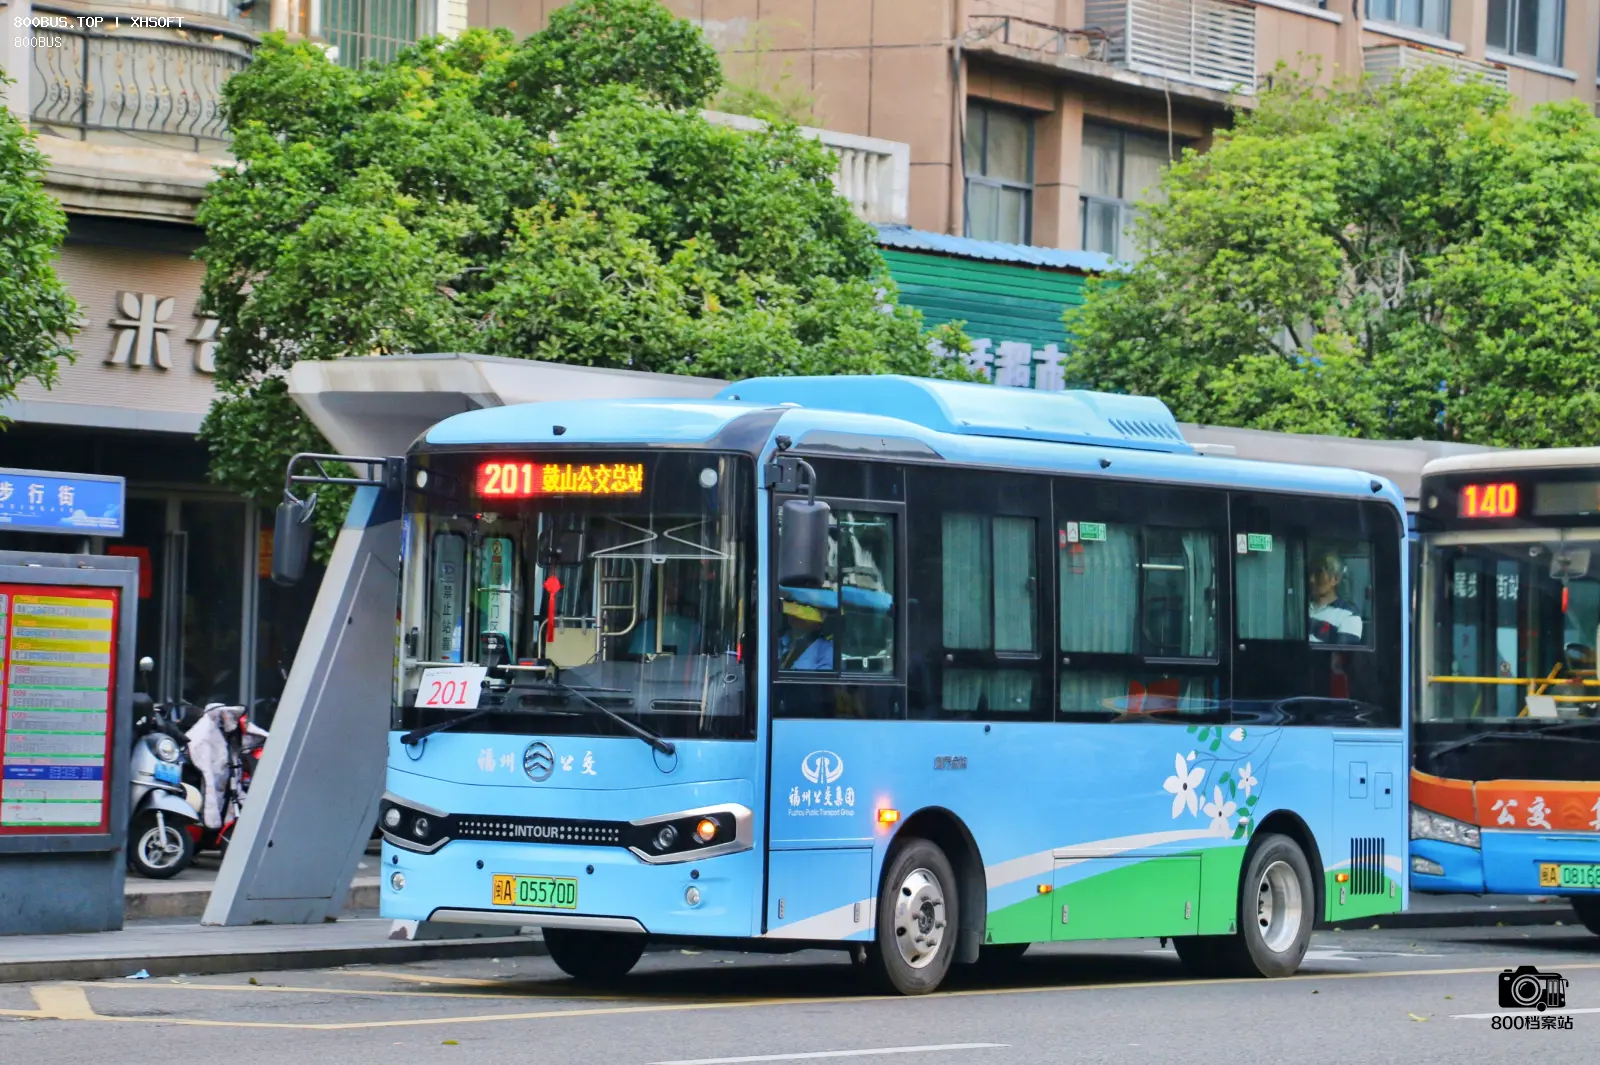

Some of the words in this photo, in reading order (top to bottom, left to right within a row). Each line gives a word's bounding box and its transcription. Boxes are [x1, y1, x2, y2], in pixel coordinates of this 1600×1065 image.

[484, 463, 533, 494] 201
[542, 463, 644, 494] 鼓山公交总站
[1464, 484, 1518, 516] 140
[426, 680, 468, 705] 201
[514, 824, 559, 839] INTOUR
